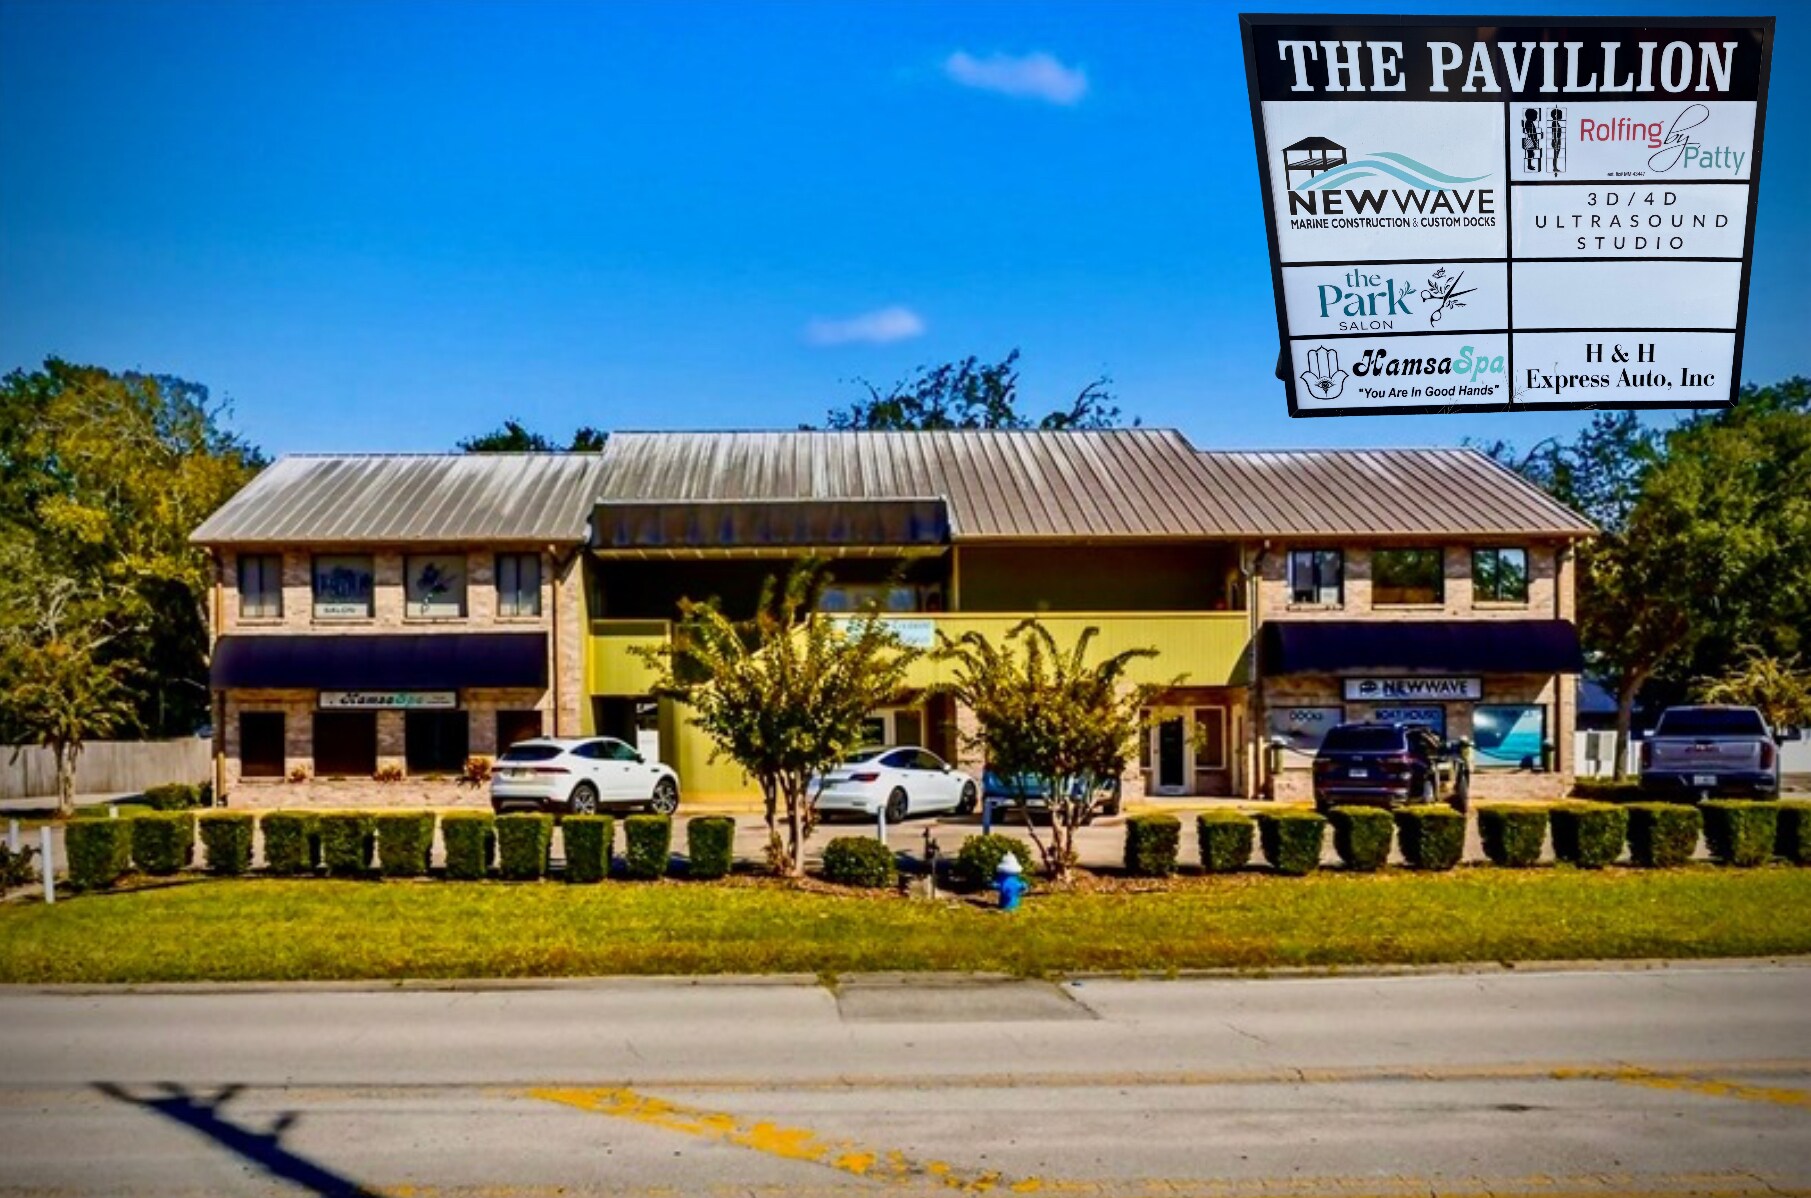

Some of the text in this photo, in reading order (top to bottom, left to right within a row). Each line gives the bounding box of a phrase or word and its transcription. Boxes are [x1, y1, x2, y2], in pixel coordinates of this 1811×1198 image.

[1277, 40, 1739, 93] THE PAVILLION
[1580, 104, 1709, 173] Rolfing by
[1683, 146, 1745, 175] Patty
[1587, 191, 1677, 206] 3D/4D
[1291, 216, 1496, 229] MARINE CONSTRUCTION & CUSTOM DOCKS
[1535, 214, 1729, 228] ULTRASOUND
[1577, 236, 1684, 250] STUDIO
[1345, 268, 1382, 287] the
[1317, 279, 1415, 318] Park
[1339, 320, 1393, 331] SALON
[1586, 343, 1655, 363] H & H
[1526, 367, 1715, 394] Express Auto, Inc
[1359, 384, 1500, 399] "You Are In Good Hands"
